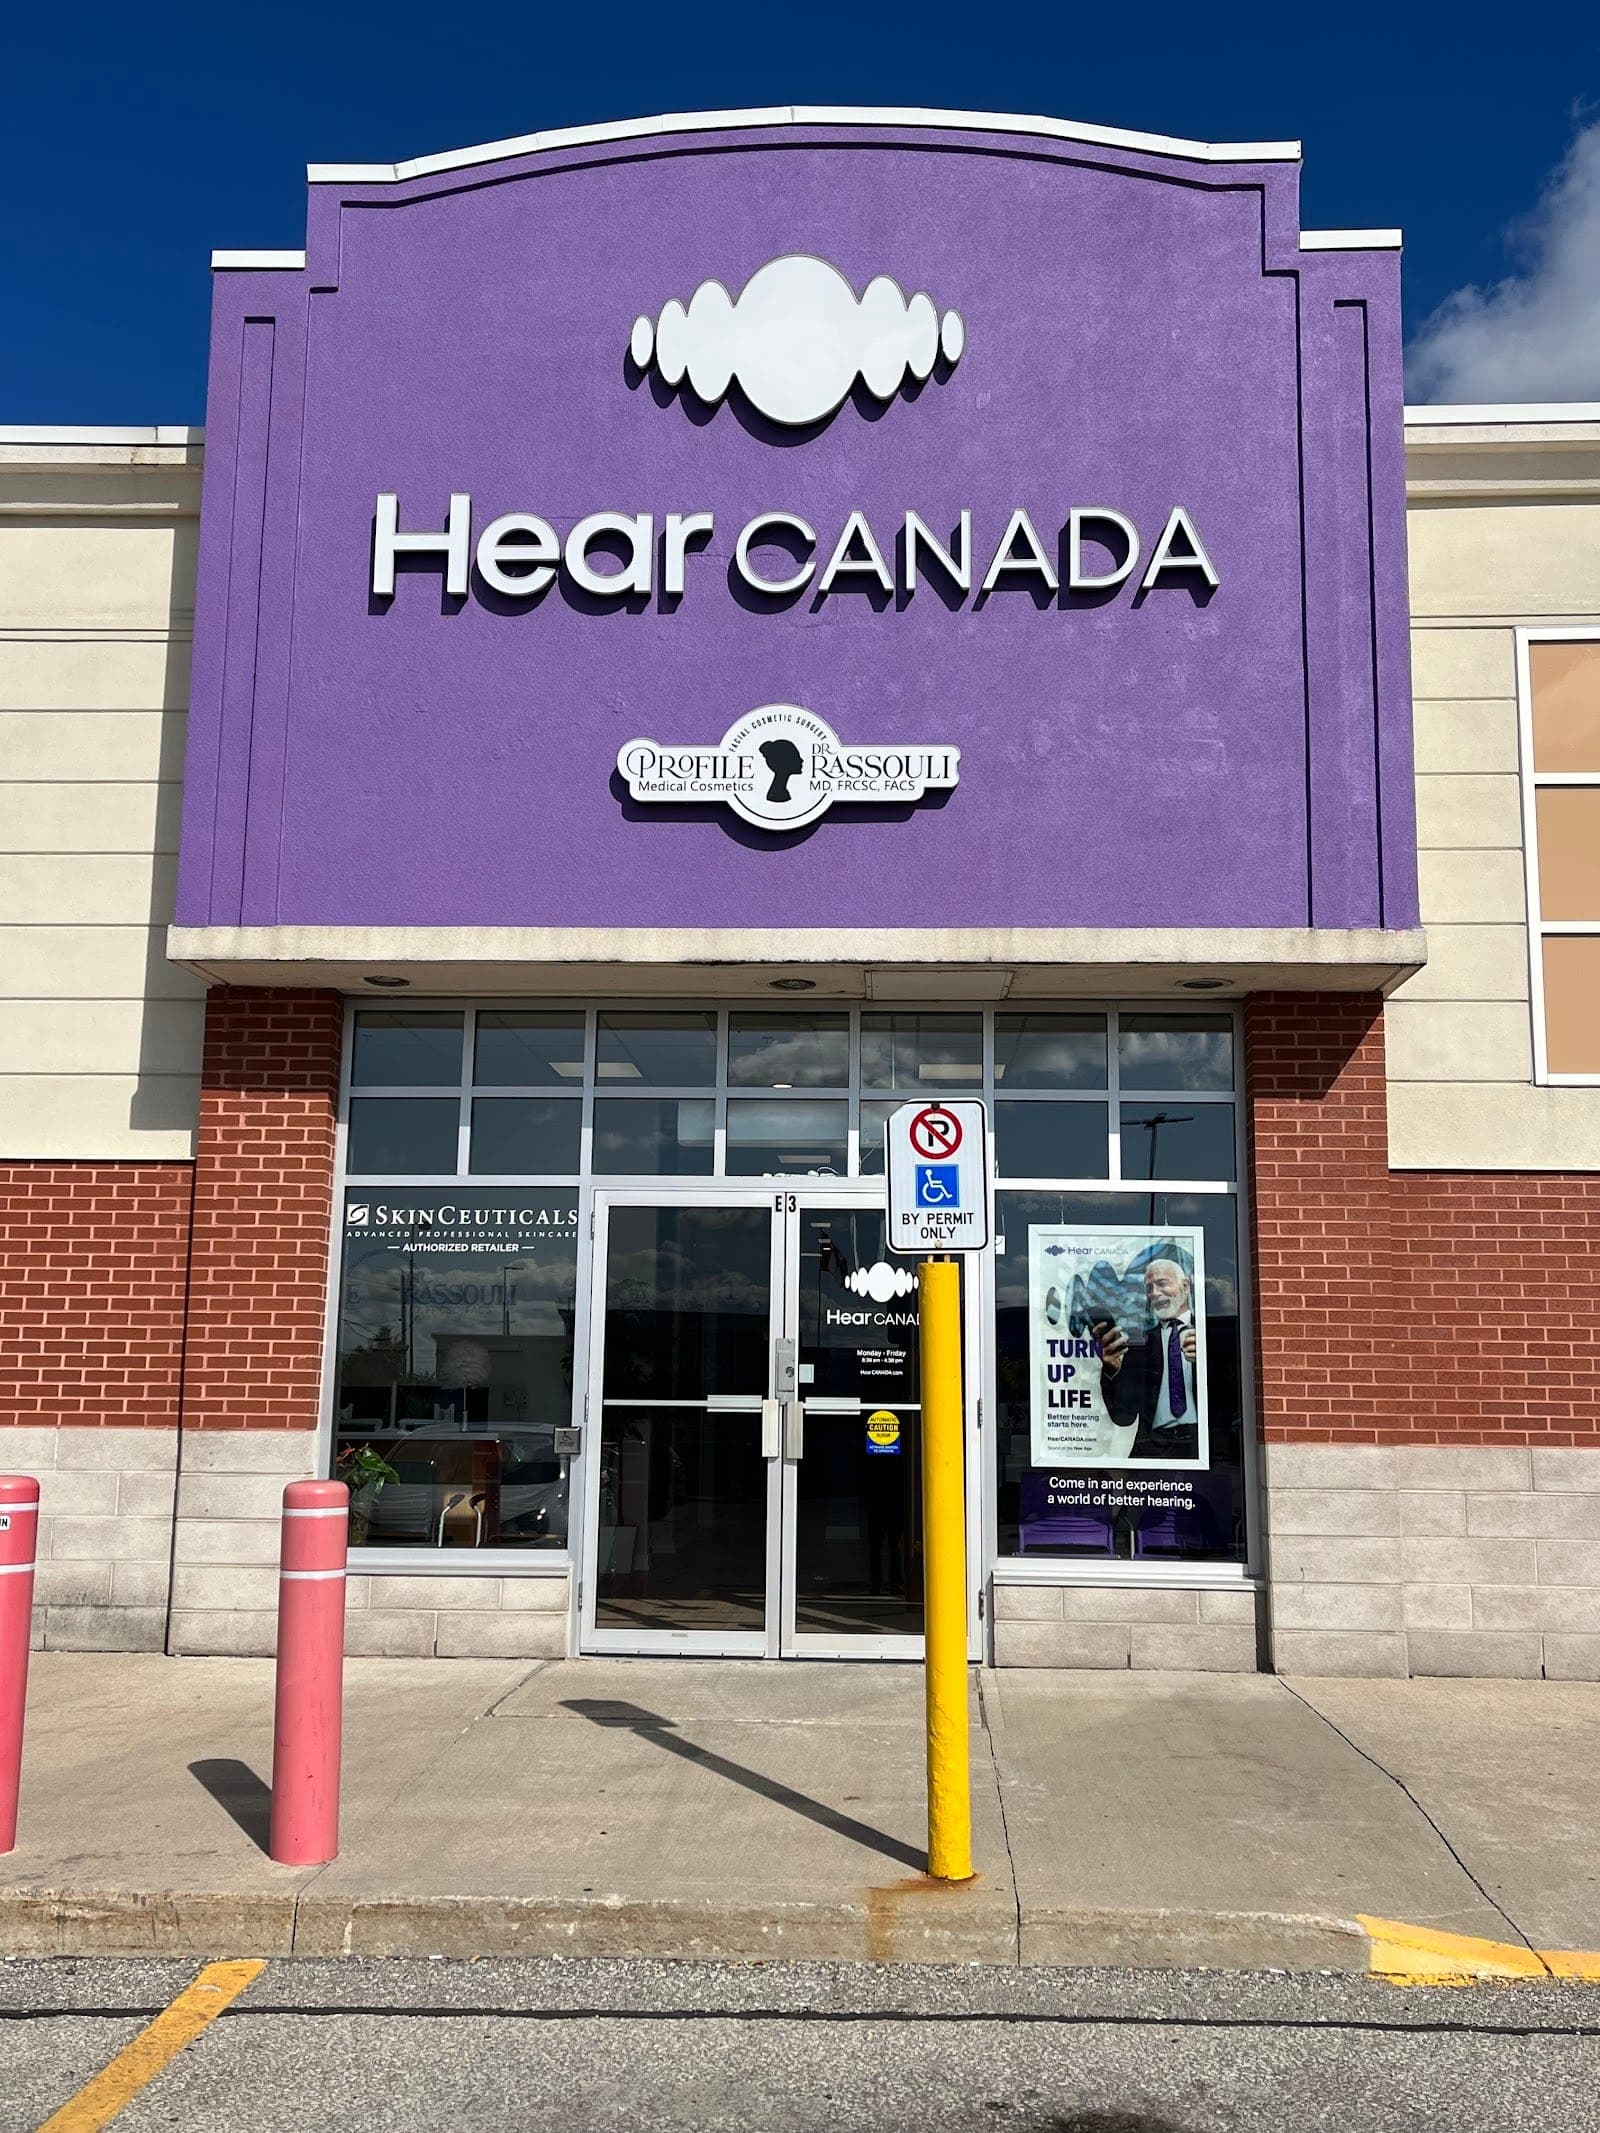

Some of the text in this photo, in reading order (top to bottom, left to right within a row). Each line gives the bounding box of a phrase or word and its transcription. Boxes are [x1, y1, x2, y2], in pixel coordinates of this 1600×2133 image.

[373, 492, 1221, 595] Hear CANADA
[729, 714, 828, 752] FACIAL COSMETIC SURGERY
[812, 743, 838, 755] DR
[811, 754, 950, 779] RASSOULI
[638, 781, 754, 792] Medical Cosmetics
[809, 780, 915, 792] MD, FRCSC, FACS
[775, 1195, 797, 1213] E 3
[902, 1212, 975, 1225] BY PERMIT
[346, 1230, 411, 1238] ADVANCED
[418, 1230, 510, 1238] PROFESSIONAL
[920, 1226, 956, 1239] ONLY
[402, 1243, 519, 1252] AUTHORIZED RETAILER
[1068, 1246, 1092, 1255] Hear
[826, 1309, 920, 1326] Hear CANA
[856, 1349, 881, 1357] Monday
[886, 1349, 907, 1357] Friday
[1046, 1339, 1104, 1358] TURN
[1048, 1364, 1076, 1383] UP
[1048, 1389, 1092, 1408] LIFE
[1072, 1414, 1100, 1422] hearing
[1049, 1477, 1193, 1493] Come in and experience
[1047, 1493, 1196, 1510] a world of better hearing.
